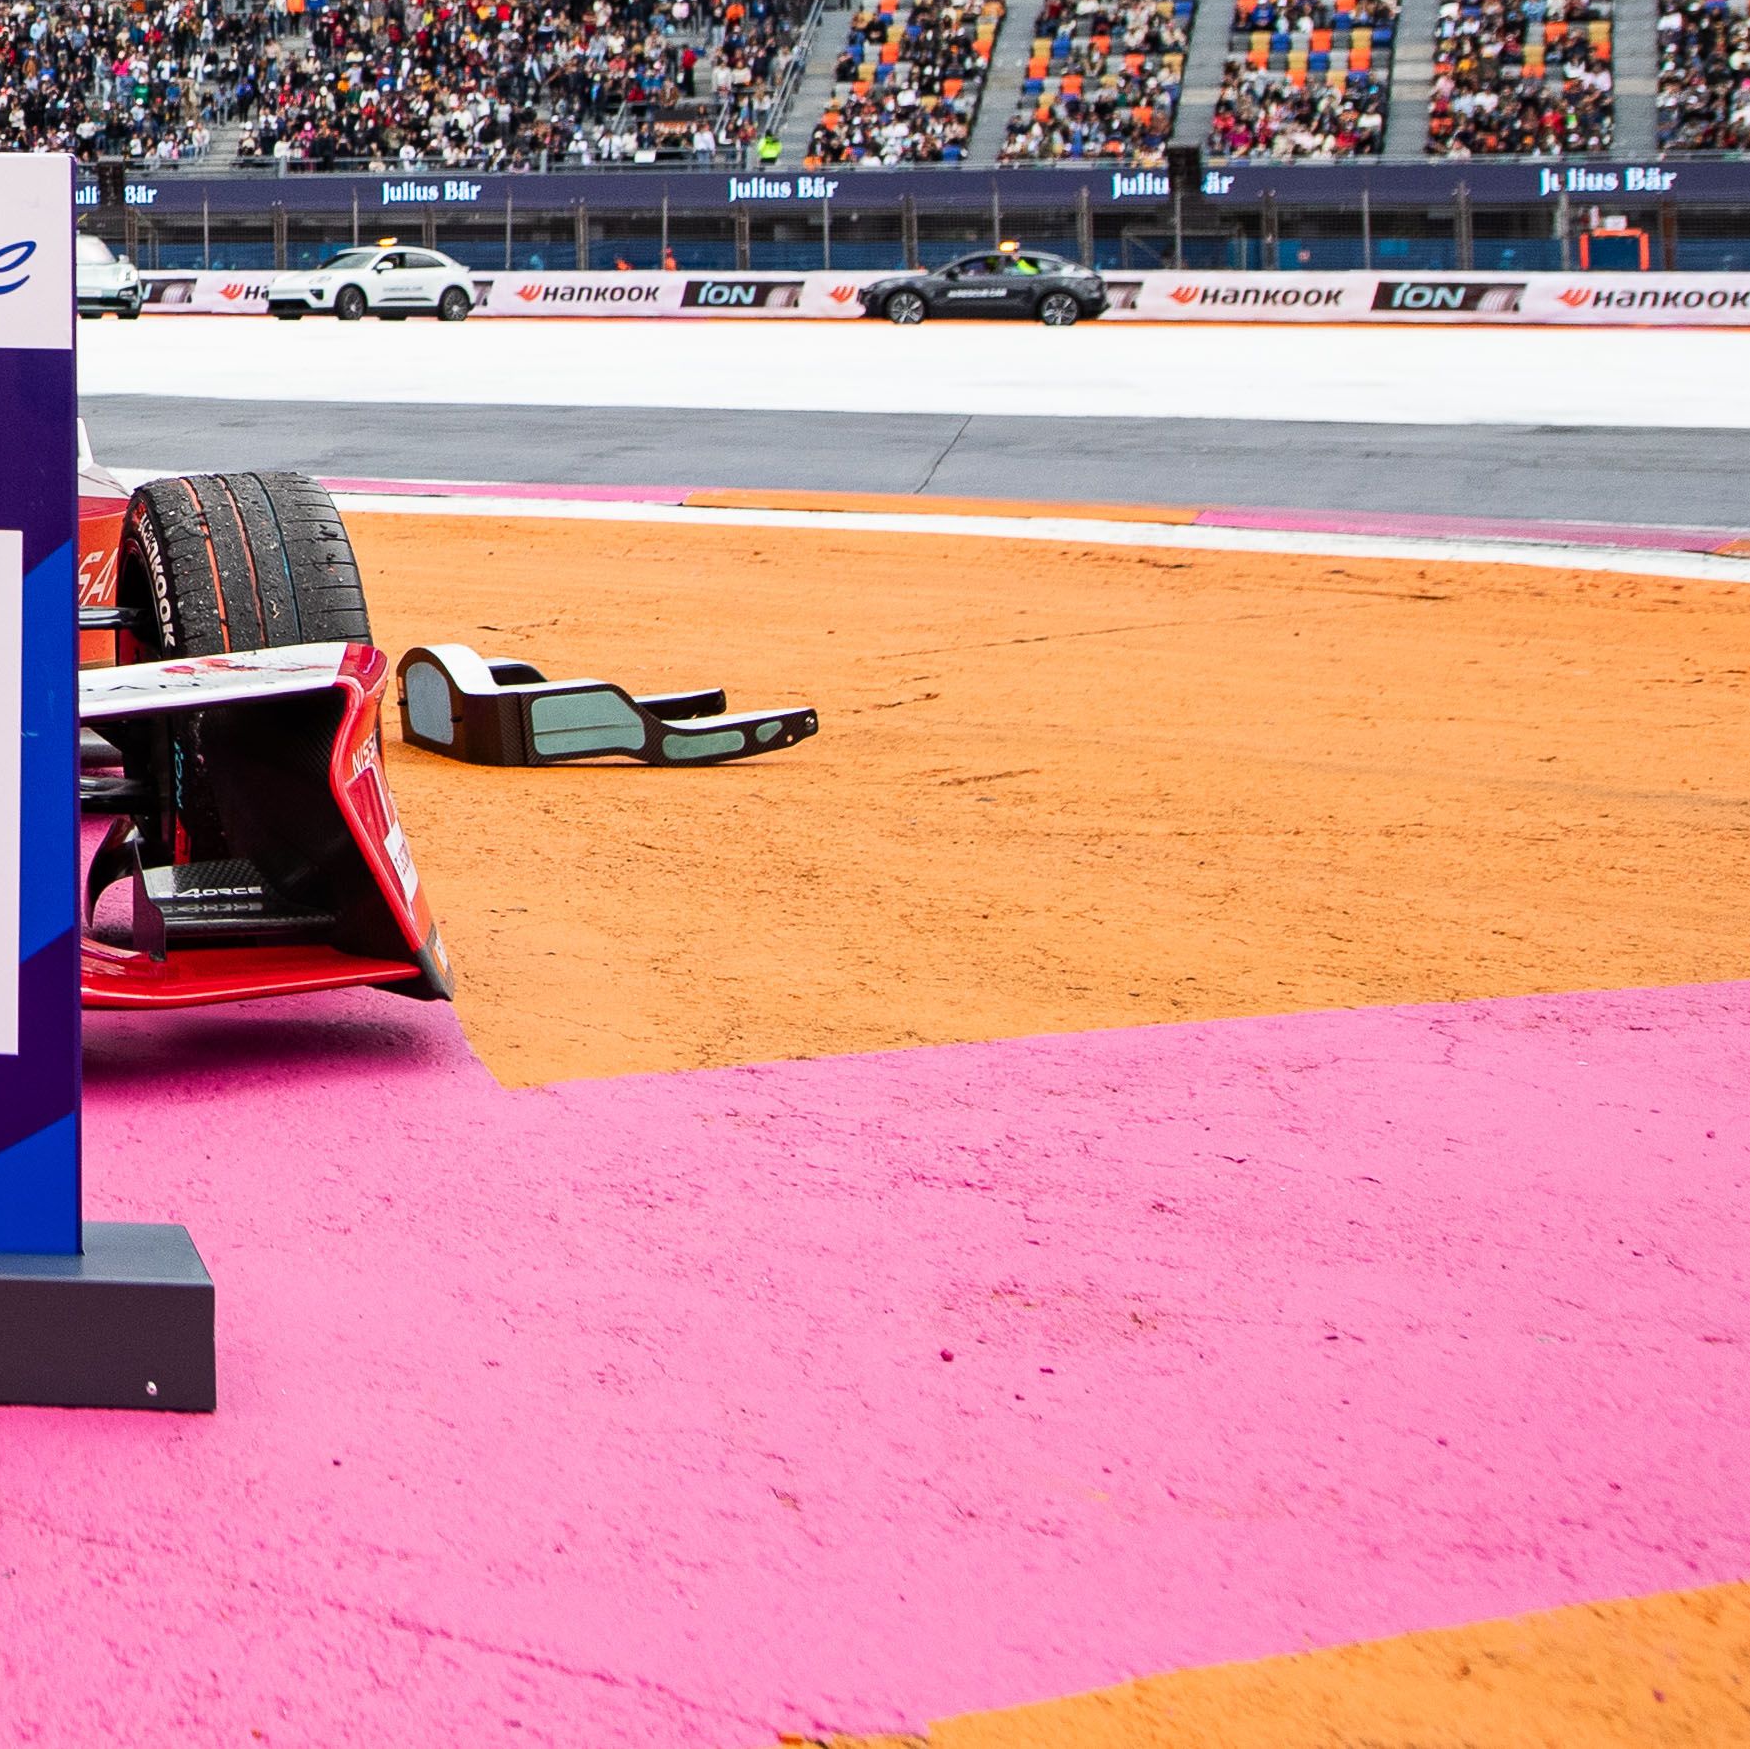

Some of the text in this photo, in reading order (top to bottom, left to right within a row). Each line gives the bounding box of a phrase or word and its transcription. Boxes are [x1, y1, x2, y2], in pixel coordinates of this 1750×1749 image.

[728, 176, 839, 202] Julius Bär
[1112, 171, 1235, 200] Juliu är
[1624, 166, 1677, 192] Bär
[124, 184, 158, 204] Bär
[382, 180, 482, 205] Julius Bär
